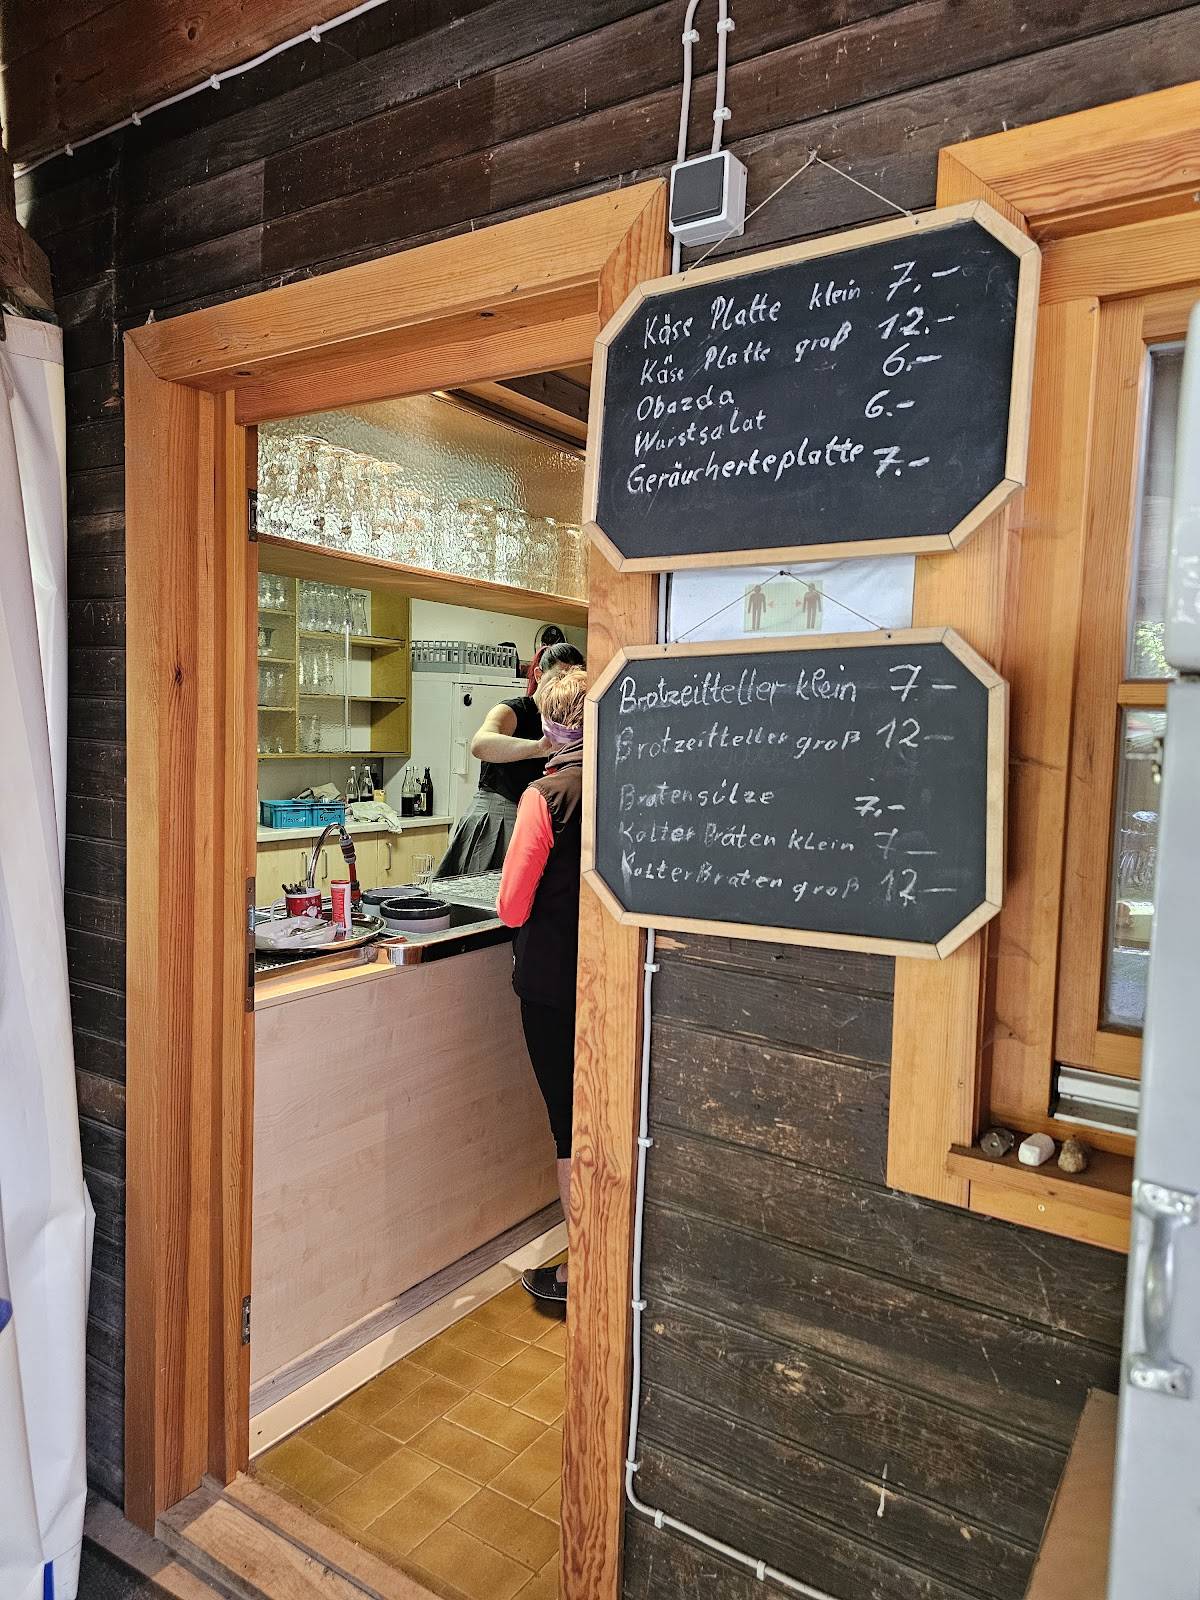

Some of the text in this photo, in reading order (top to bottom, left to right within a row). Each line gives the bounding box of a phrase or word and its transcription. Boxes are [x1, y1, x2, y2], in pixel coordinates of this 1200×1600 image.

[643, 314, 693, 349] Käse
[711, 294, 782, 332] Platte
[809, 279, 861, 311] klein
[640, 355, 685, 386] Käse
[794, 321, 852, 362] groß
[636, 386, 734, 421] Obazda
[634, 409, 767, 458] Wurstsalat
[627, 436, 865, 494] Geräucherteplatte
[796, 665, 857, 702] klein
[794, 730, 861, 759] groß
